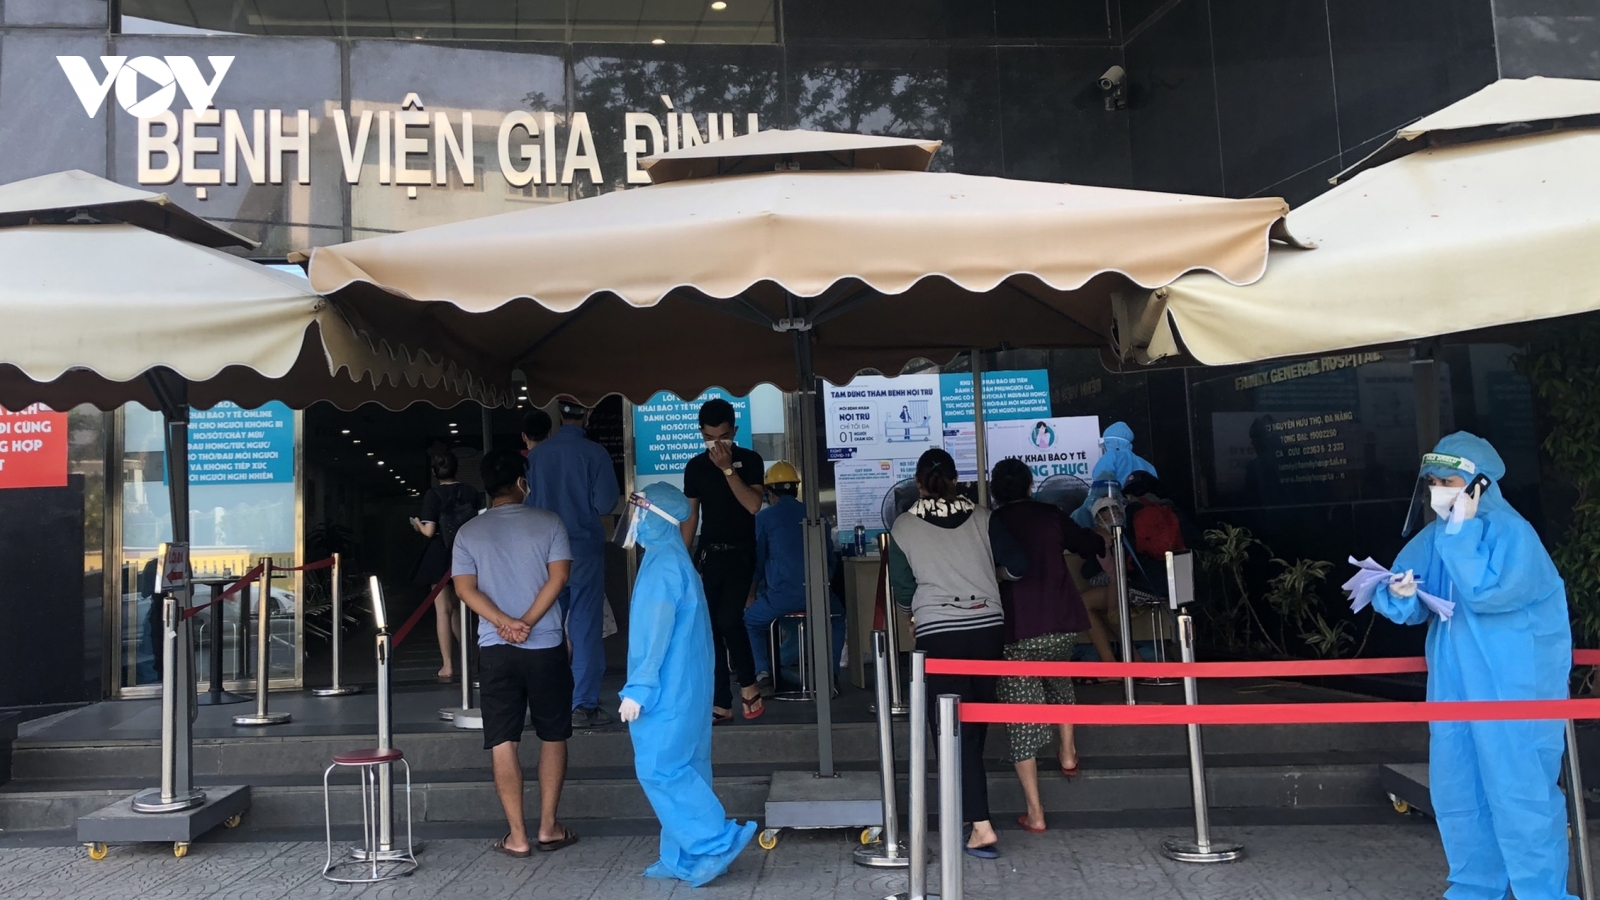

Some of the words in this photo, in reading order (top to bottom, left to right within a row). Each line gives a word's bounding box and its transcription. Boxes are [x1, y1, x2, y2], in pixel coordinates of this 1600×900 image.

[138, 98, 310, 199] BỆNH
[334, 92, 474, 199] VIỆN
[498, 110, 603, 187] GIA
[1270, 360, 1320, 383] GENERAL
[14, 420, 52, 434] CÙNG
[840, 431, 852, 443] 01
[12, 439, 42, 452] HỢP
[1025, 454, 1046, 463] KHAI
